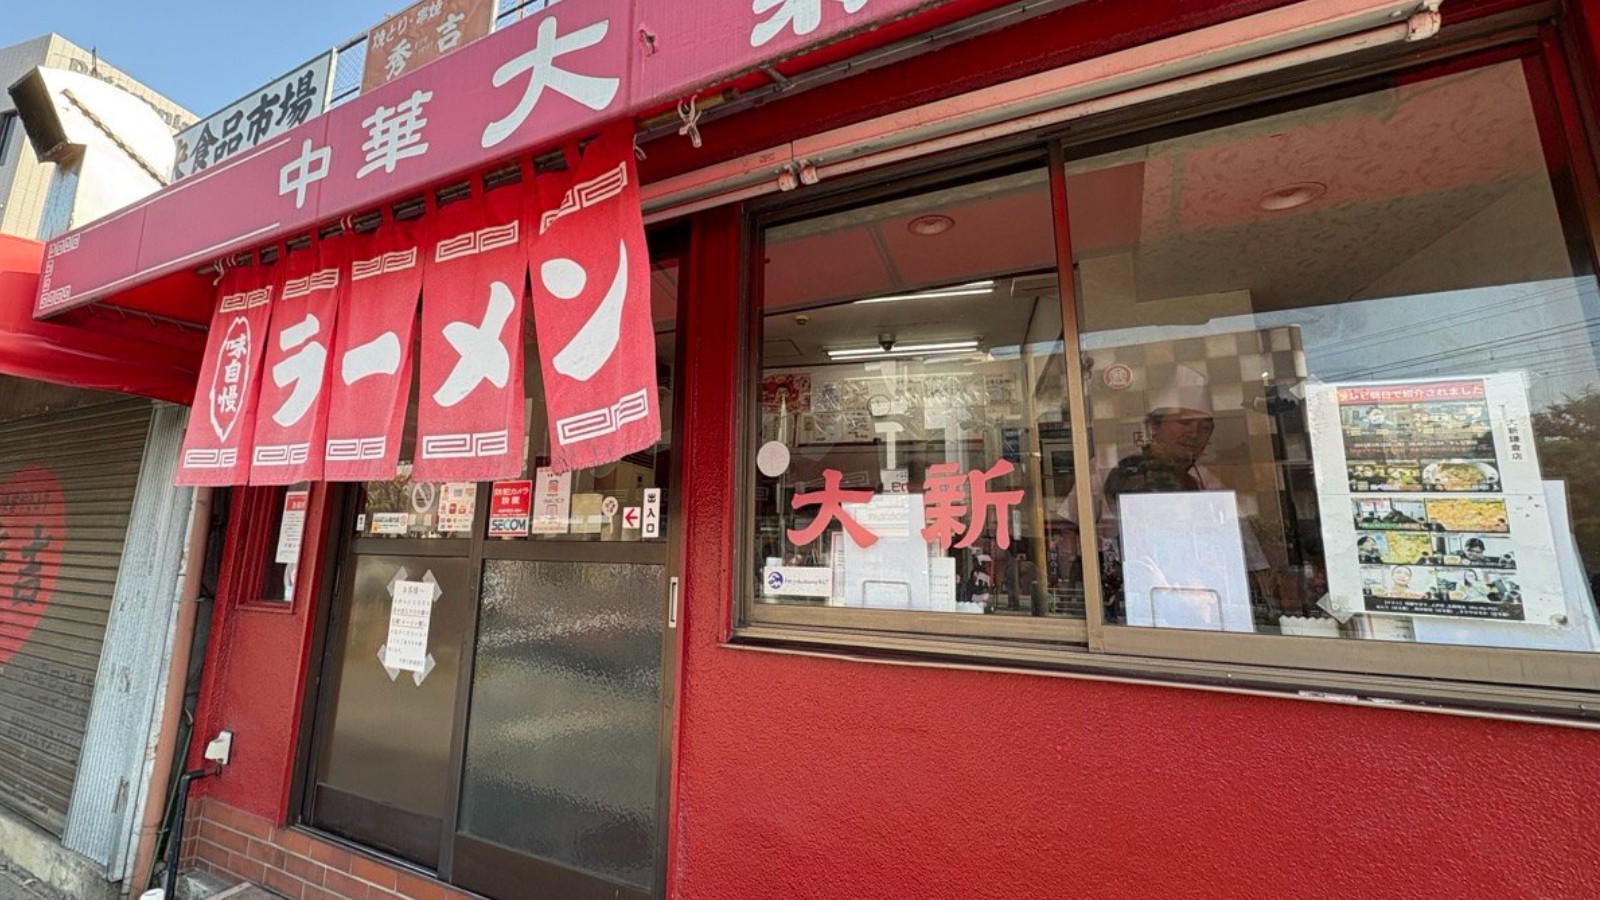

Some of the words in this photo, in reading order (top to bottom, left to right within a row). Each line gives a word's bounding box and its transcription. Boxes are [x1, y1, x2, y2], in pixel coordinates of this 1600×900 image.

[385, 12, 466, 81] 秀吉
[279, 91, 433, 210] 中華
[272, 239, 628, 428] ラーメン
[217, 335, 249, 414] 味自慢
[491, 518, 526, 531] SECOM
[494, 487, 530, 497] 防犯カメラ
[646, 493, 657, 533] 出入口
[786, 459, 1025, 549] 大新
